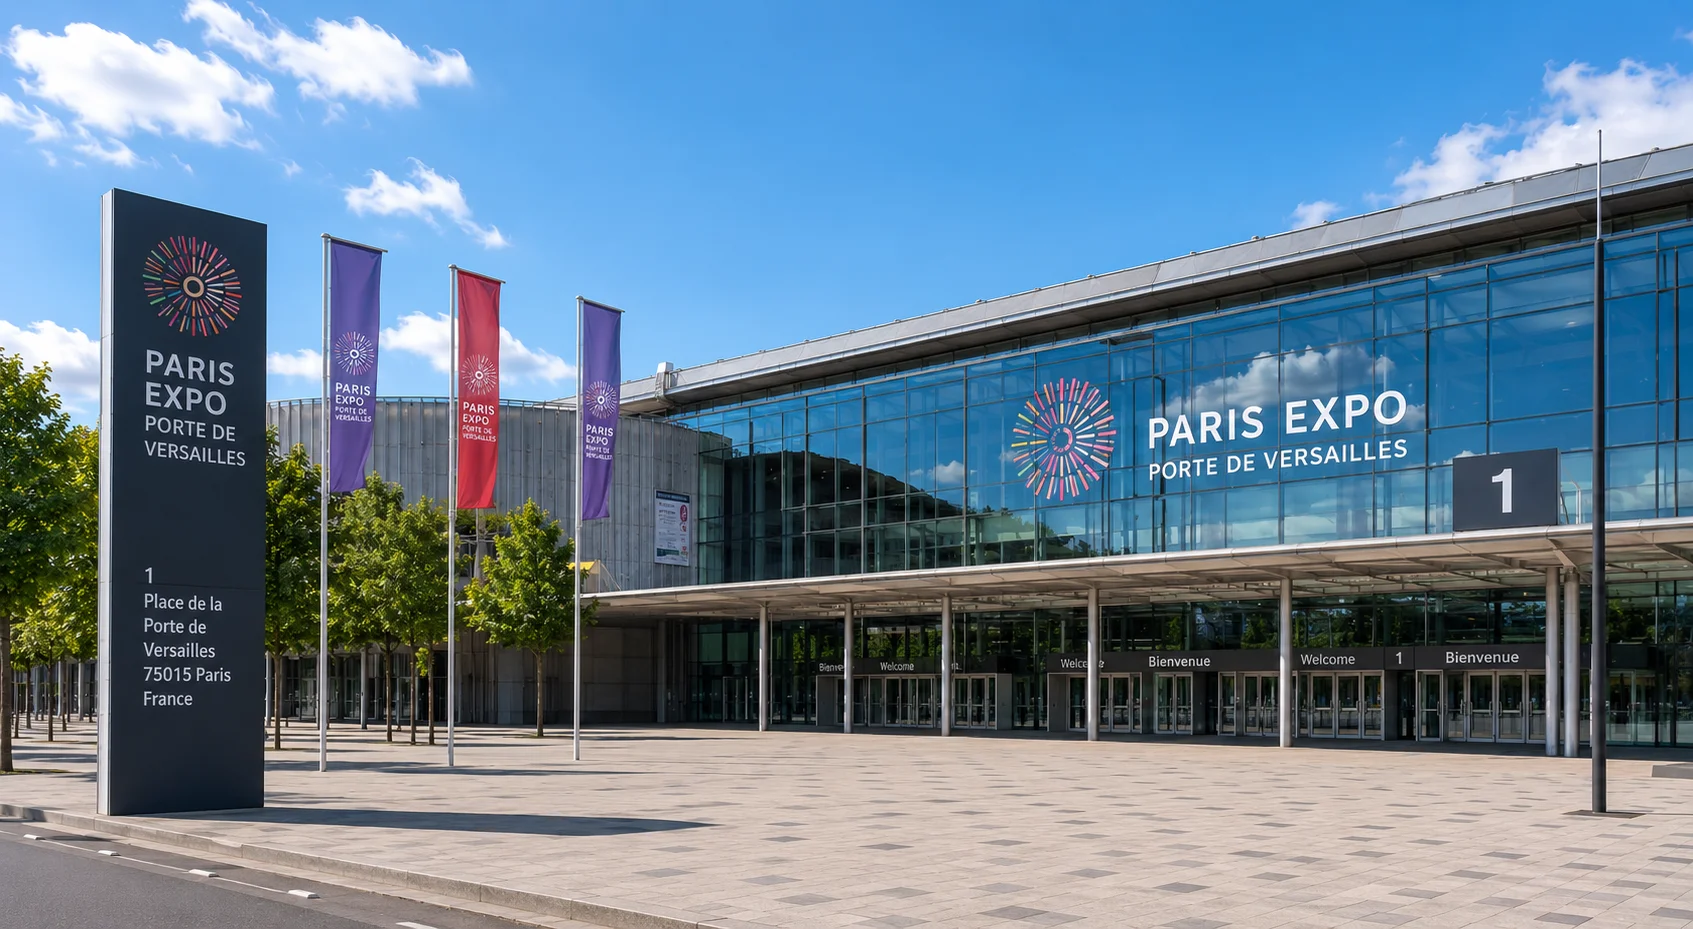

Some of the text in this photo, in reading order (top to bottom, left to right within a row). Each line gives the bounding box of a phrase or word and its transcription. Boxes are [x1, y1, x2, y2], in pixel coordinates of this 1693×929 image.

[146, 349, 235, 386] PARIS
[335, 382, 371, 396] PARIS
[145, 381, 227, 416] EXPO
[335, 394, 364, 407] EXPO
[463, 401, 495, 416] PARIS
[462, 413, 490, 426] EXPO
[1148, 390, 1408, 449] PARIS EXPO
[145, 414, 236, 442] PORTE DE
[586, 424, 614, 437] PARIS
[585, 434, 609, 446] EXPO
[144, 440, 246, 467] VERSAILLES
[1149, 439, 1408, 481] PORTE DE VERSAILLES
[1492, 468, 1512, 513] 1
[145, 567, 153, 584] 1
[144, 593, 223, 612] Place de la
[144, 617, 207, 634] Porte de
[143, 642, 216, 658] Versailles
[1446, 651, 1520, 664] Bienvenue
[1060, 658, 1105, 669] Welce
[1149, 656, 1211, 668] Bienvenue
[1301, 654, 1356, 665] Welcome
[1396, 652, 1403, 664] 1
[880, 661, 915, 671] Welcome
[143, 666, 232, 682] 75015 Paris
[143, 691, 193, 706] France
